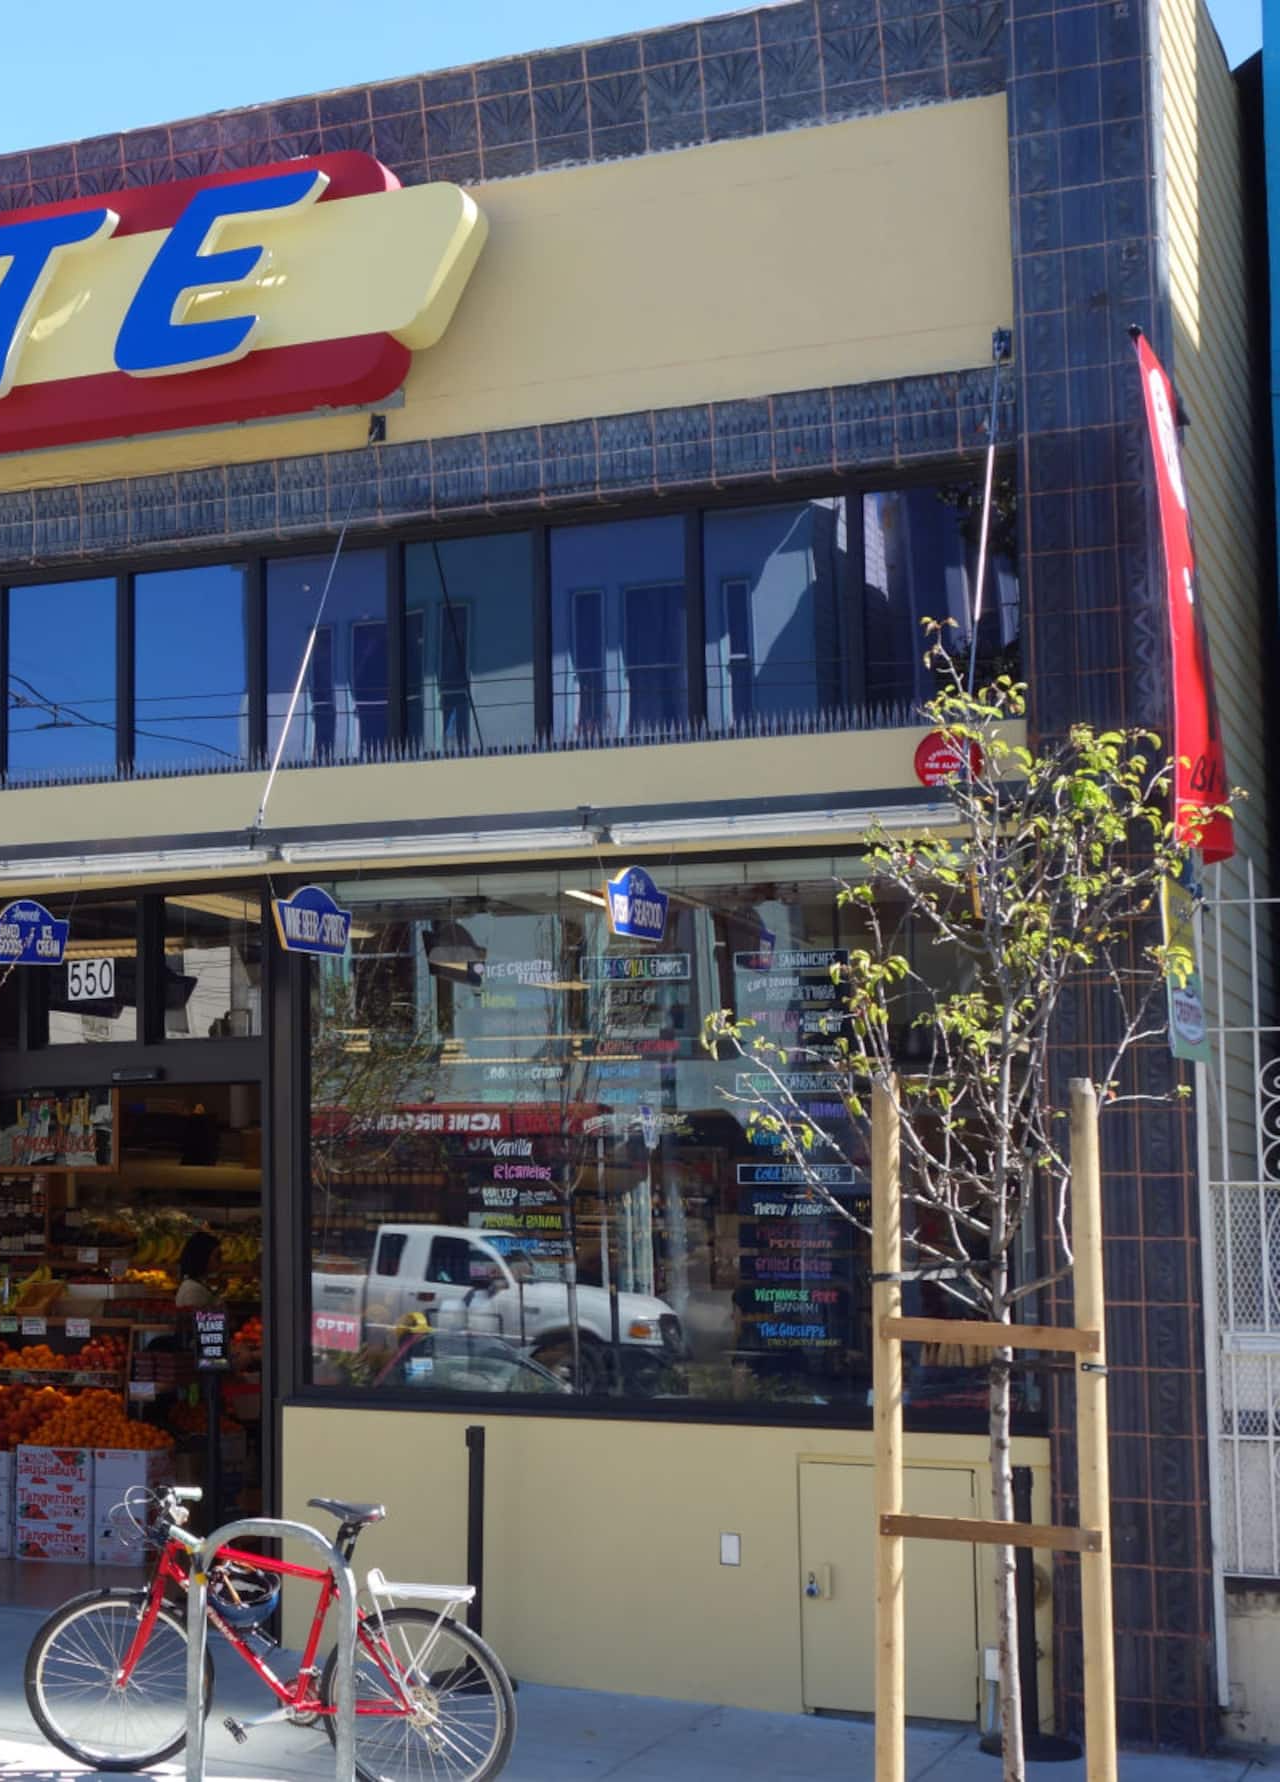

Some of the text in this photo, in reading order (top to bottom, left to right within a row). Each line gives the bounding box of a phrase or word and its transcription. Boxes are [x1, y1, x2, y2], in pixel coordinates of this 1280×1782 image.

[634, 899, 662, 929] SEAFOOD
[36, 940, 61, 957] CREAM
[70, 959, 113, 998] 550
[197, 1320, 224, 1332] PLEASE
[316, 1318, 354, 1334] OPEN
[18, 1487, 87, 1506] Tangerines
[18, 1526, 87, 1546] Tangerines
